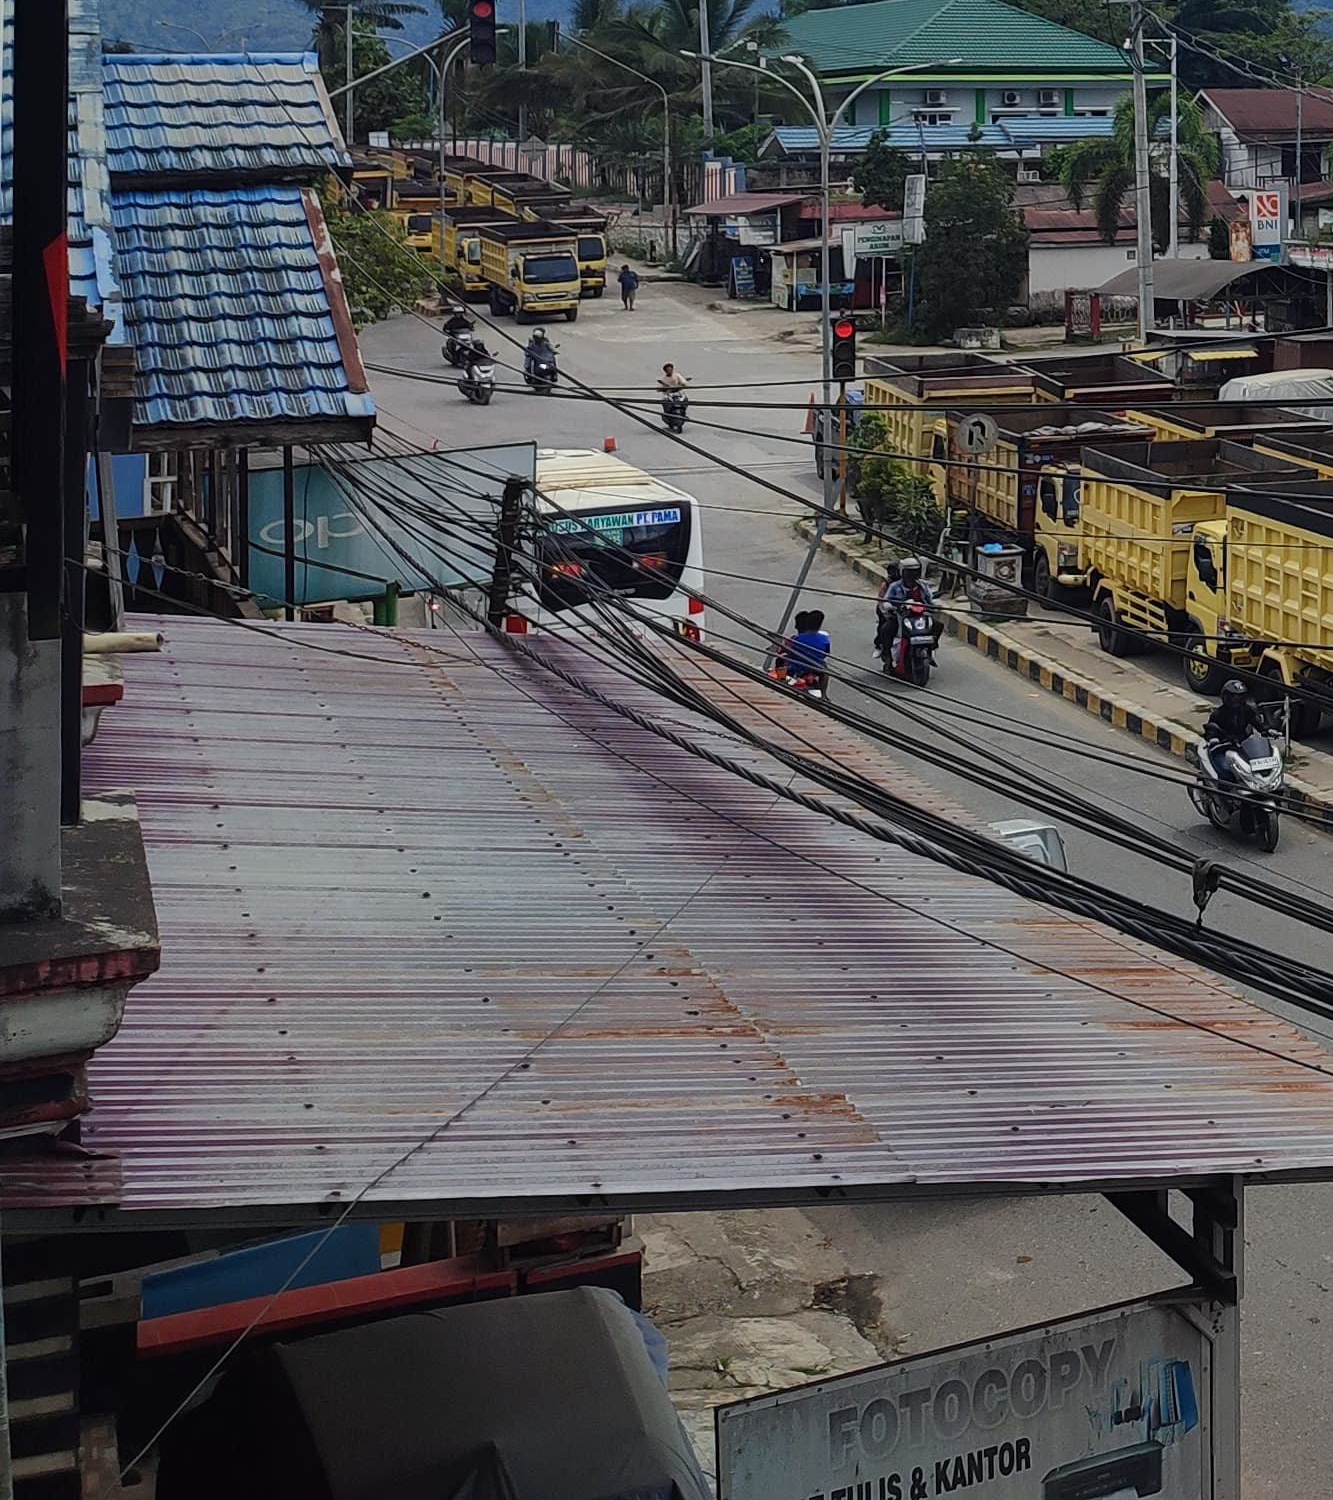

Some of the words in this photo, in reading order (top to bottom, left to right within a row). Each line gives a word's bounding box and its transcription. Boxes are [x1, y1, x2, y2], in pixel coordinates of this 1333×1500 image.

[1257, 219, 1278, 230] BNI
[651, 510, 679, 523] PAMA
[828, 1340, 1118, 1470] FOTOCOPY
[910, 1466, 928, 1500] &
[935, 1437, 1032, 1496] KANTOR
